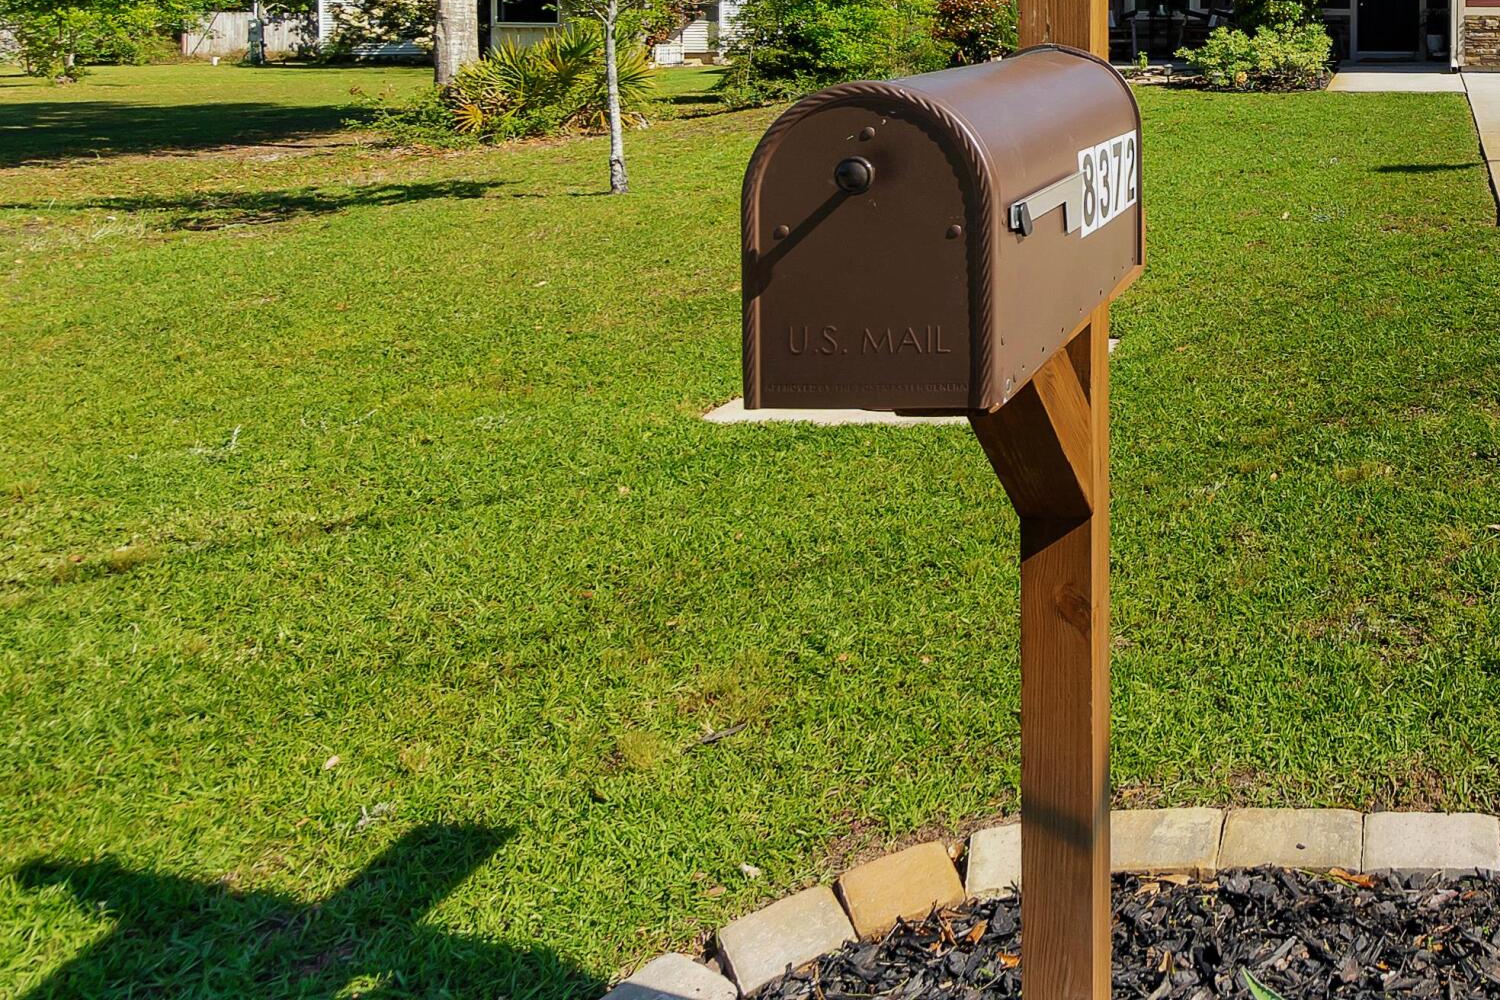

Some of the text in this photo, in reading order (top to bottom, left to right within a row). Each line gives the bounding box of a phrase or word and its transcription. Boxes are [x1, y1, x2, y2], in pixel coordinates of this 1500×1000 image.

[1082, 137, 1135, 228] 8372
[788, 325, 952, 355] U.S. MAIL
